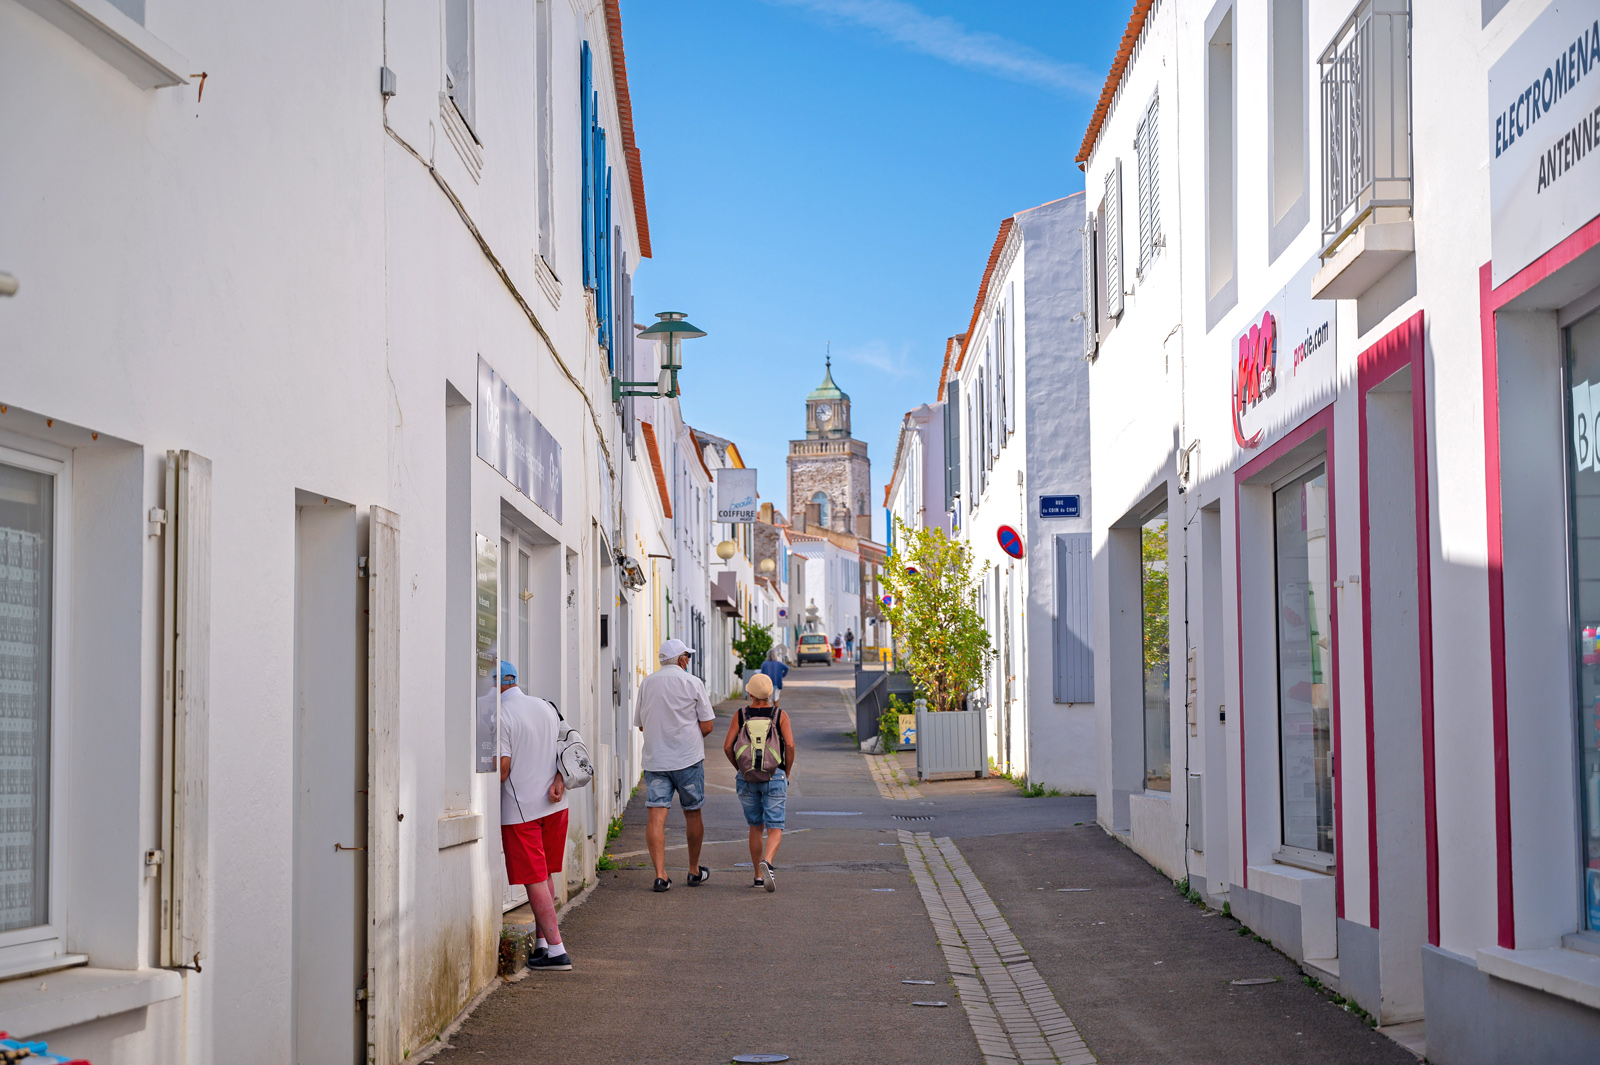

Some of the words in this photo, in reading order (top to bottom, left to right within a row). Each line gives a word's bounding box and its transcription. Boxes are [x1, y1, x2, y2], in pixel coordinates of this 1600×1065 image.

[1495, 19, 1600, 159] ELECTROMENA
[1537, 105, 1600, 194] ANTENNE
[1237, 310, 1274, 414] PRO
[1294, 320, 1328, 377] procie.com
